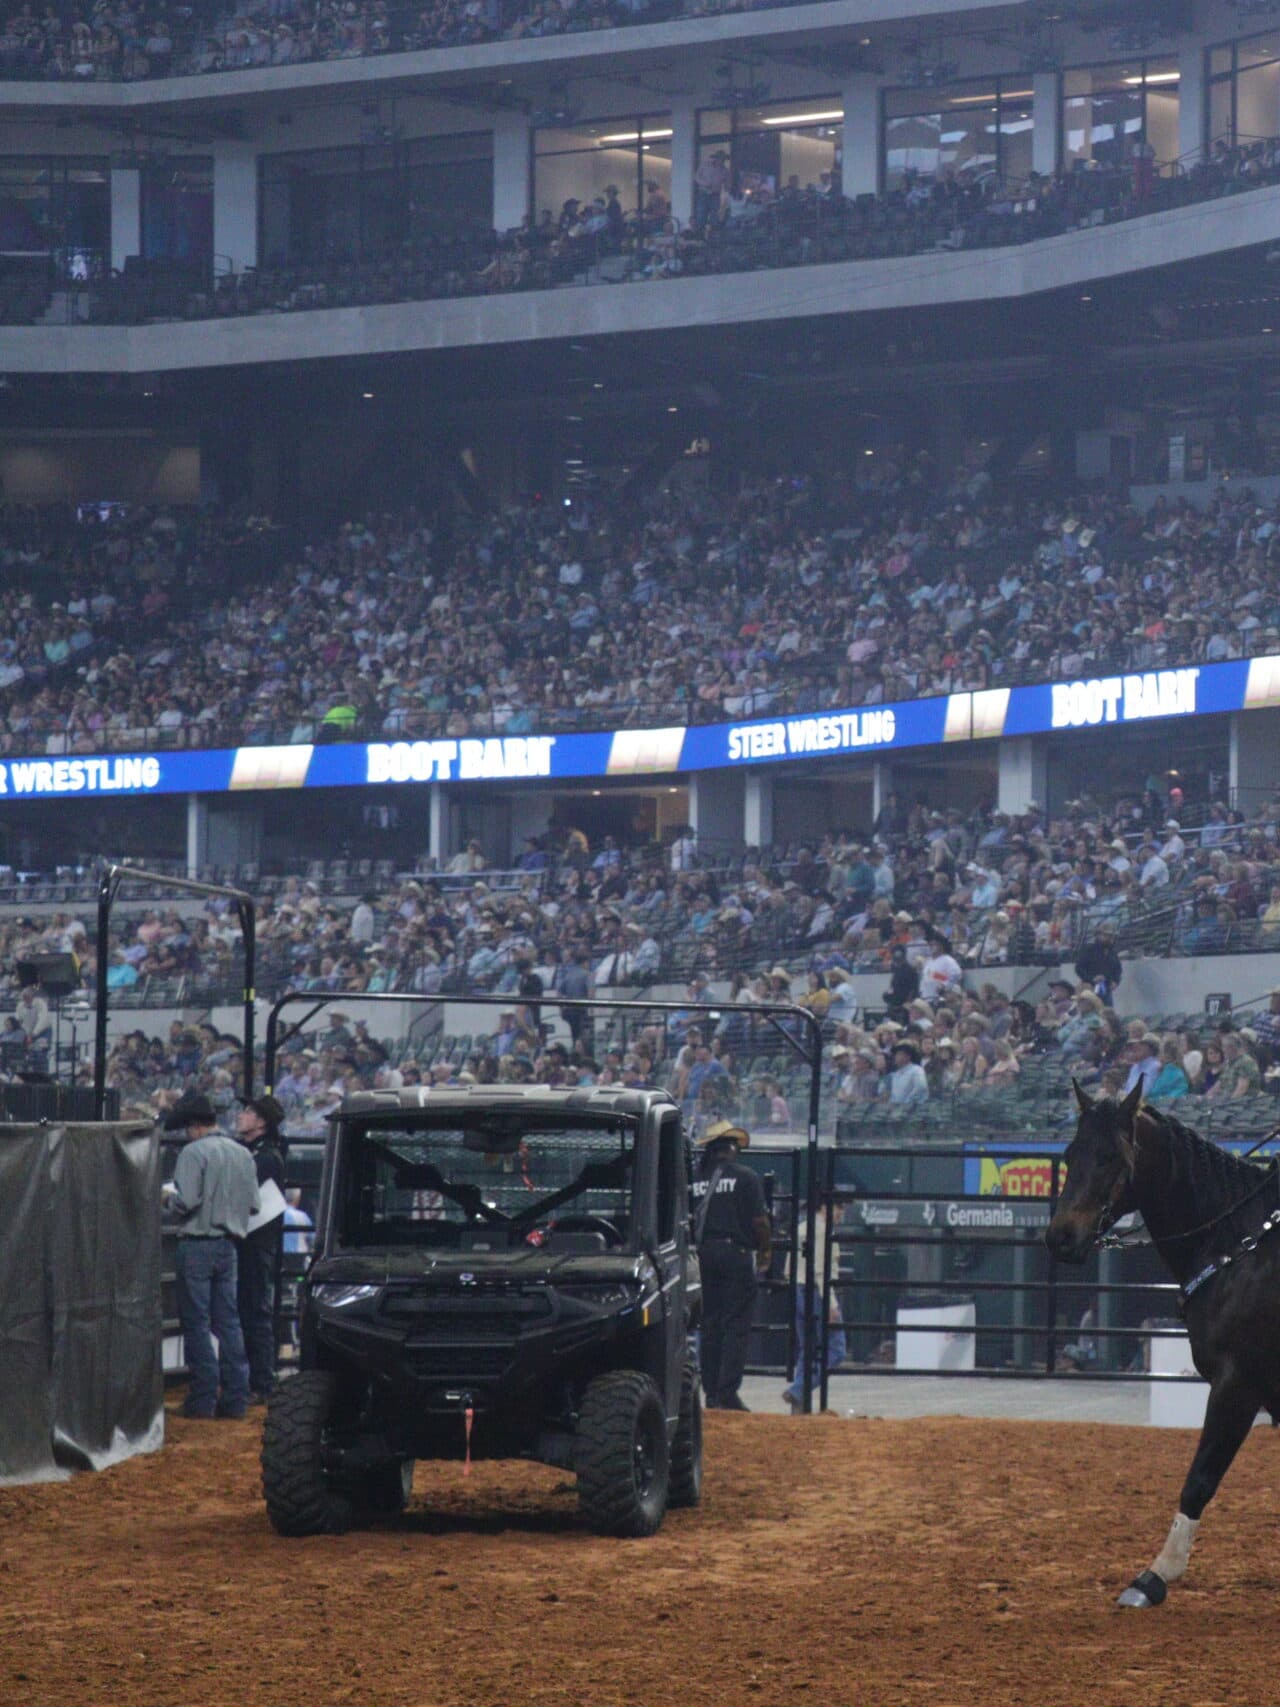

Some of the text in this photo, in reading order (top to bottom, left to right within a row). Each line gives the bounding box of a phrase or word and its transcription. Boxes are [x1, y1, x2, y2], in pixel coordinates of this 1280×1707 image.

[1052, 669, 1197, 728] BOOT BARN
[728, 711, 896, 760] STEER WRESTLING
[11, 758, 160, 794] WRESTLING
[367, 737, 552, 783] BOOT BARN
[688, 1178, 737, 1197] ECITY
[947, 1202, 1013, 1227] Germania
